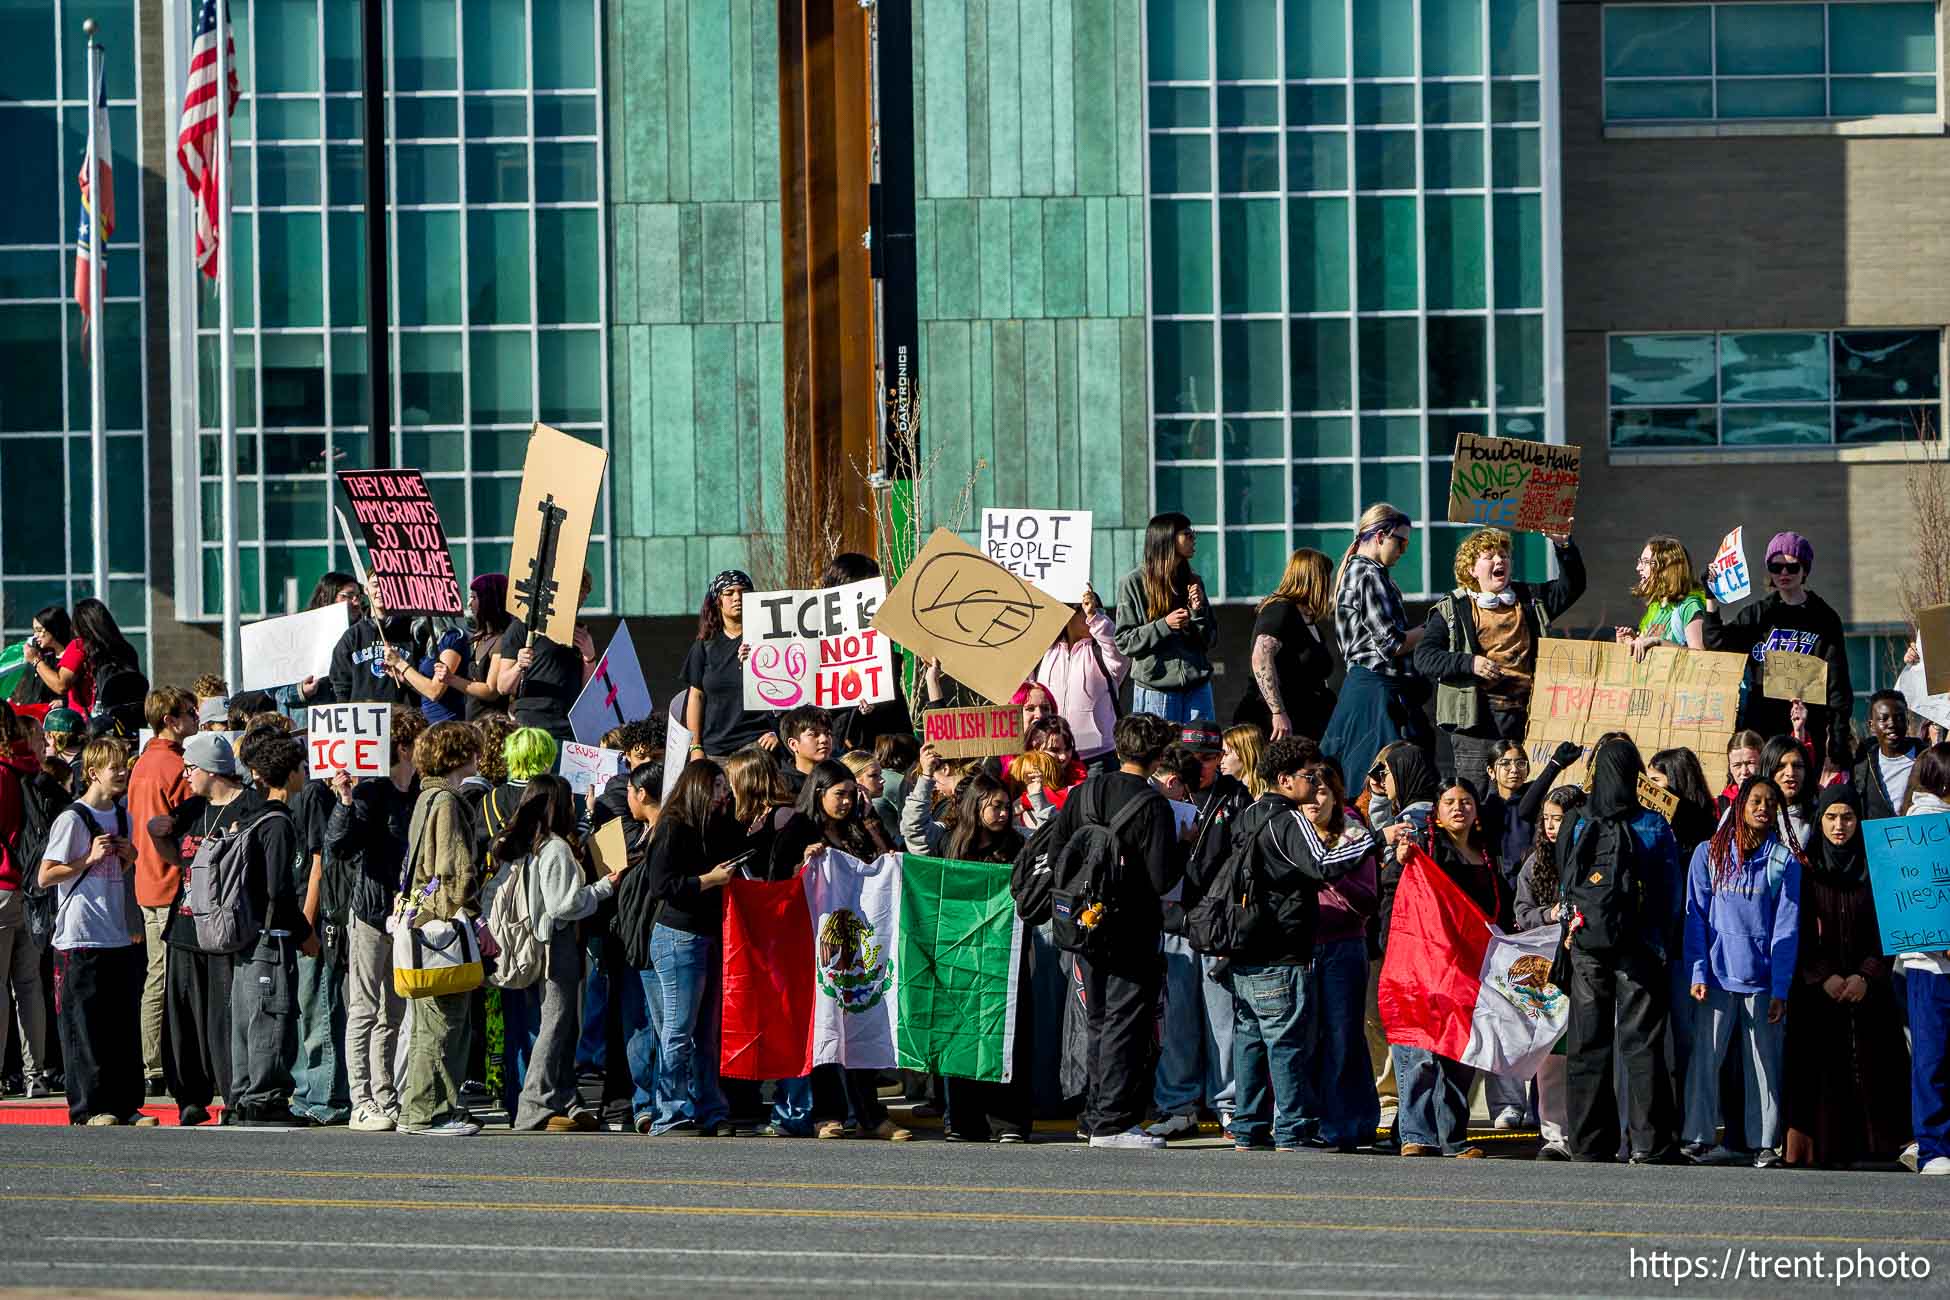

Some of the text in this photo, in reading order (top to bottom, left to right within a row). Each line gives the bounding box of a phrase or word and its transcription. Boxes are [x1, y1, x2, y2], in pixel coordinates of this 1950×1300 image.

[898, 345, 908, 431] DAKTRONICS
[343, 476, 427, 497] THEY BLAME
[1452, 462, 1532, 505] MONEY
[1481, 488, 1512, 500] for
[352, 500, 438, 525] IMMIGRANTS
[988, 513, 1071, 540] HOT
[1471, 498, 1518, 526] ICE
[373, 523, 440, 550] SO YOU
[988, 539, 1072, 563] PEOPLE
[369, 548, 454, 577] DONT BLAME
[1718, 551, 1739, 571] THE
[378, 575, 462, 612] BILLIONAIRES
[760, 591, 848, 640] I.C.E.
[929, 569, 1031, 650] ICE
[820, 629, 878, 663] NOT
[815, 665, 883, 706] HOT
[311, 707, 387, 737] MELT
[925, 709, 1019, 743] ABOLISH ICE
[311, 739, 378, 770] ICE
[566, 743, 600, 760] CRUSH
[1900, 866, 1920, 880] no
